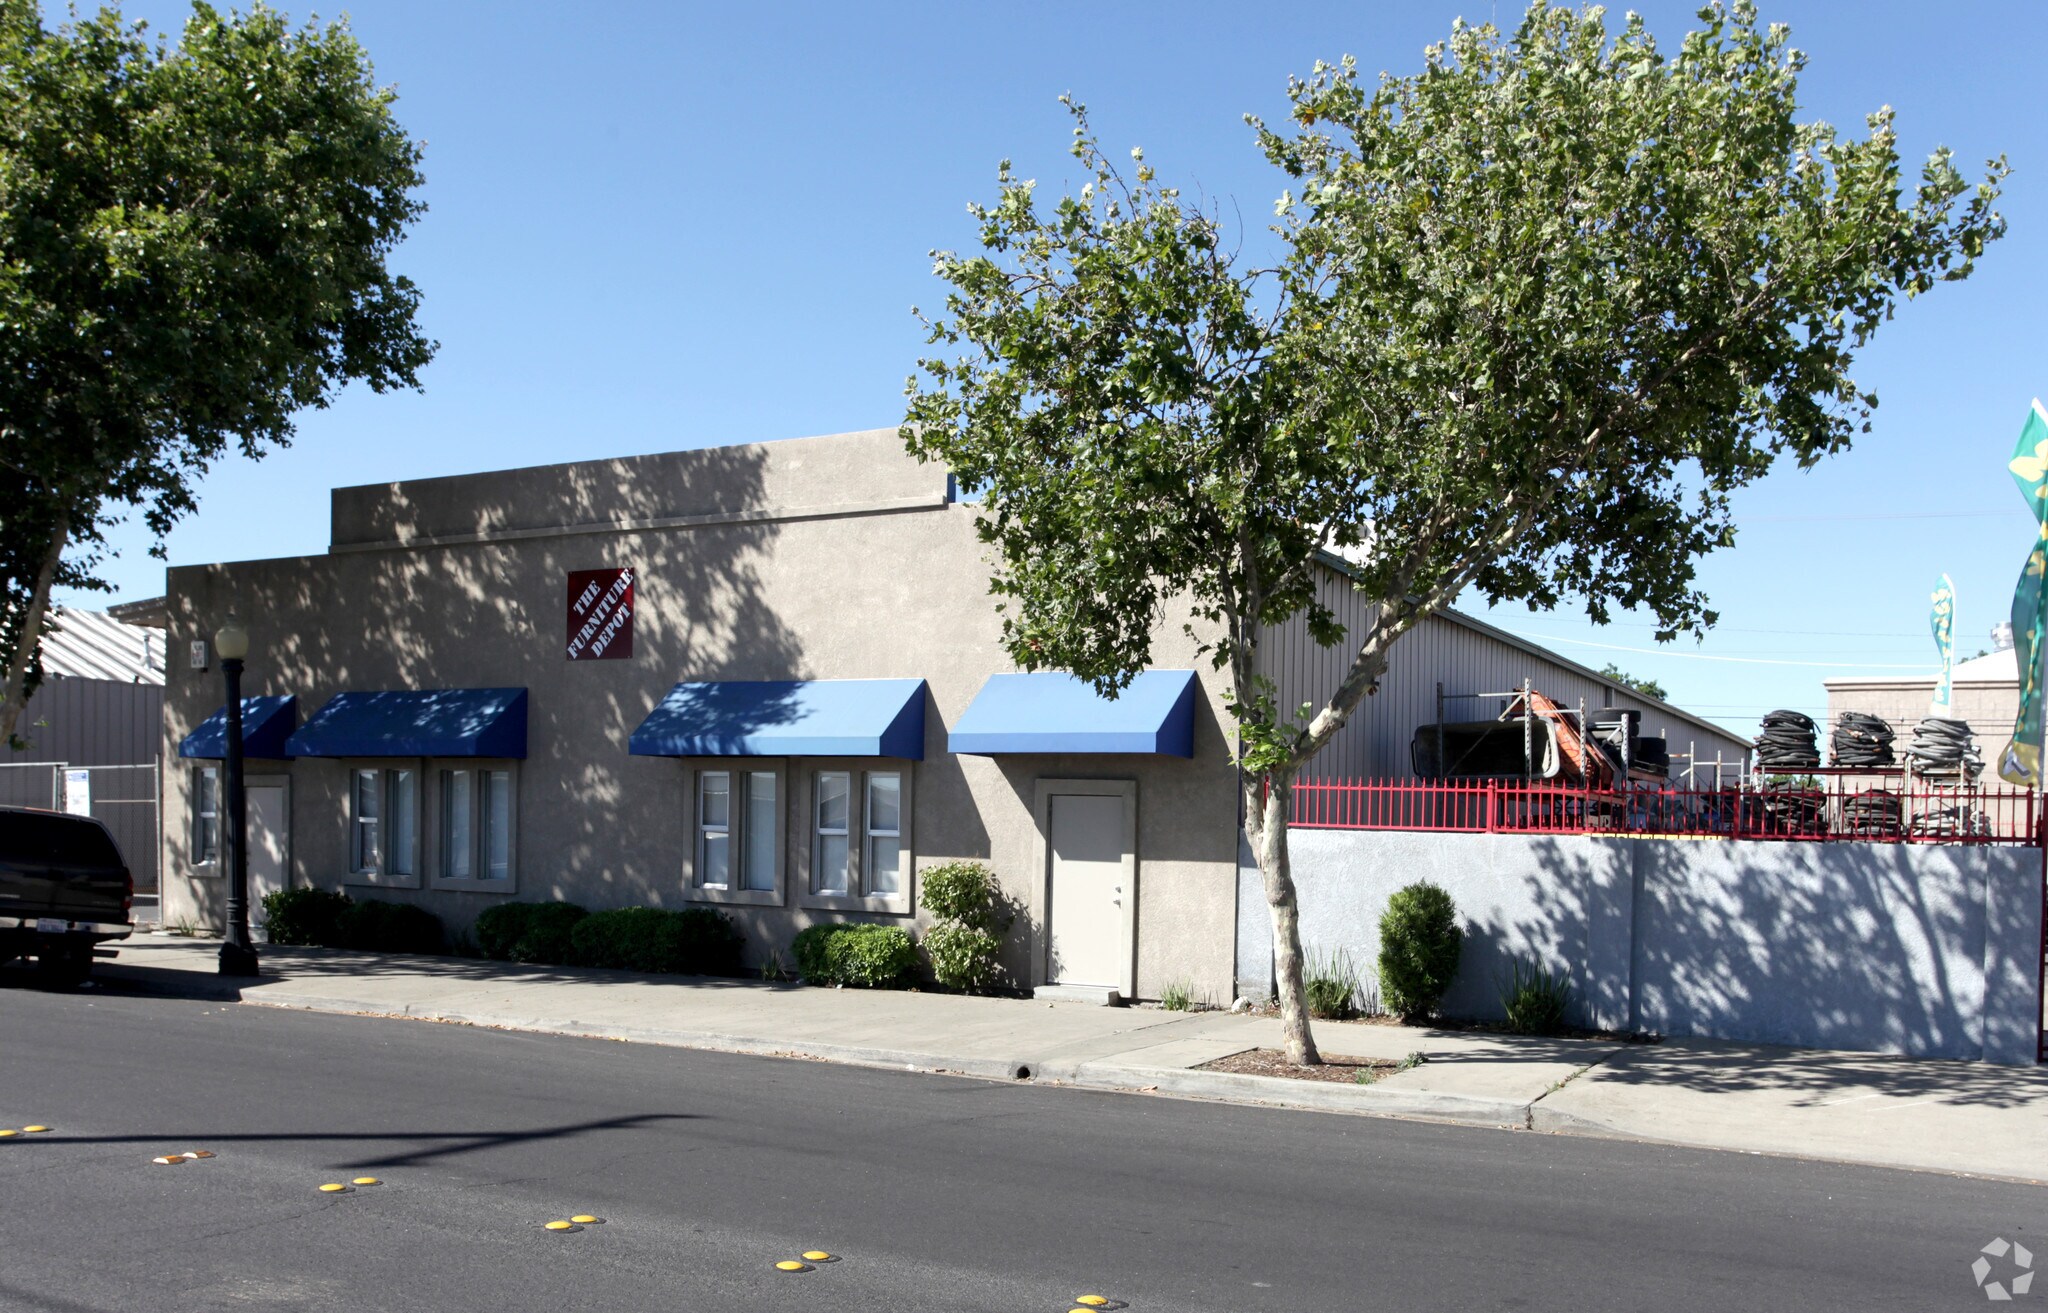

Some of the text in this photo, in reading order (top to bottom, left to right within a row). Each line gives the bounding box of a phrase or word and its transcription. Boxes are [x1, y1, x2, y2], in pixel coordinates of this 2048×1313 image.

[567, 568, 633, 659] FURNITURE
[573, 580, 601, 615] THE
[591, 602, 630, 657] DEPOT
